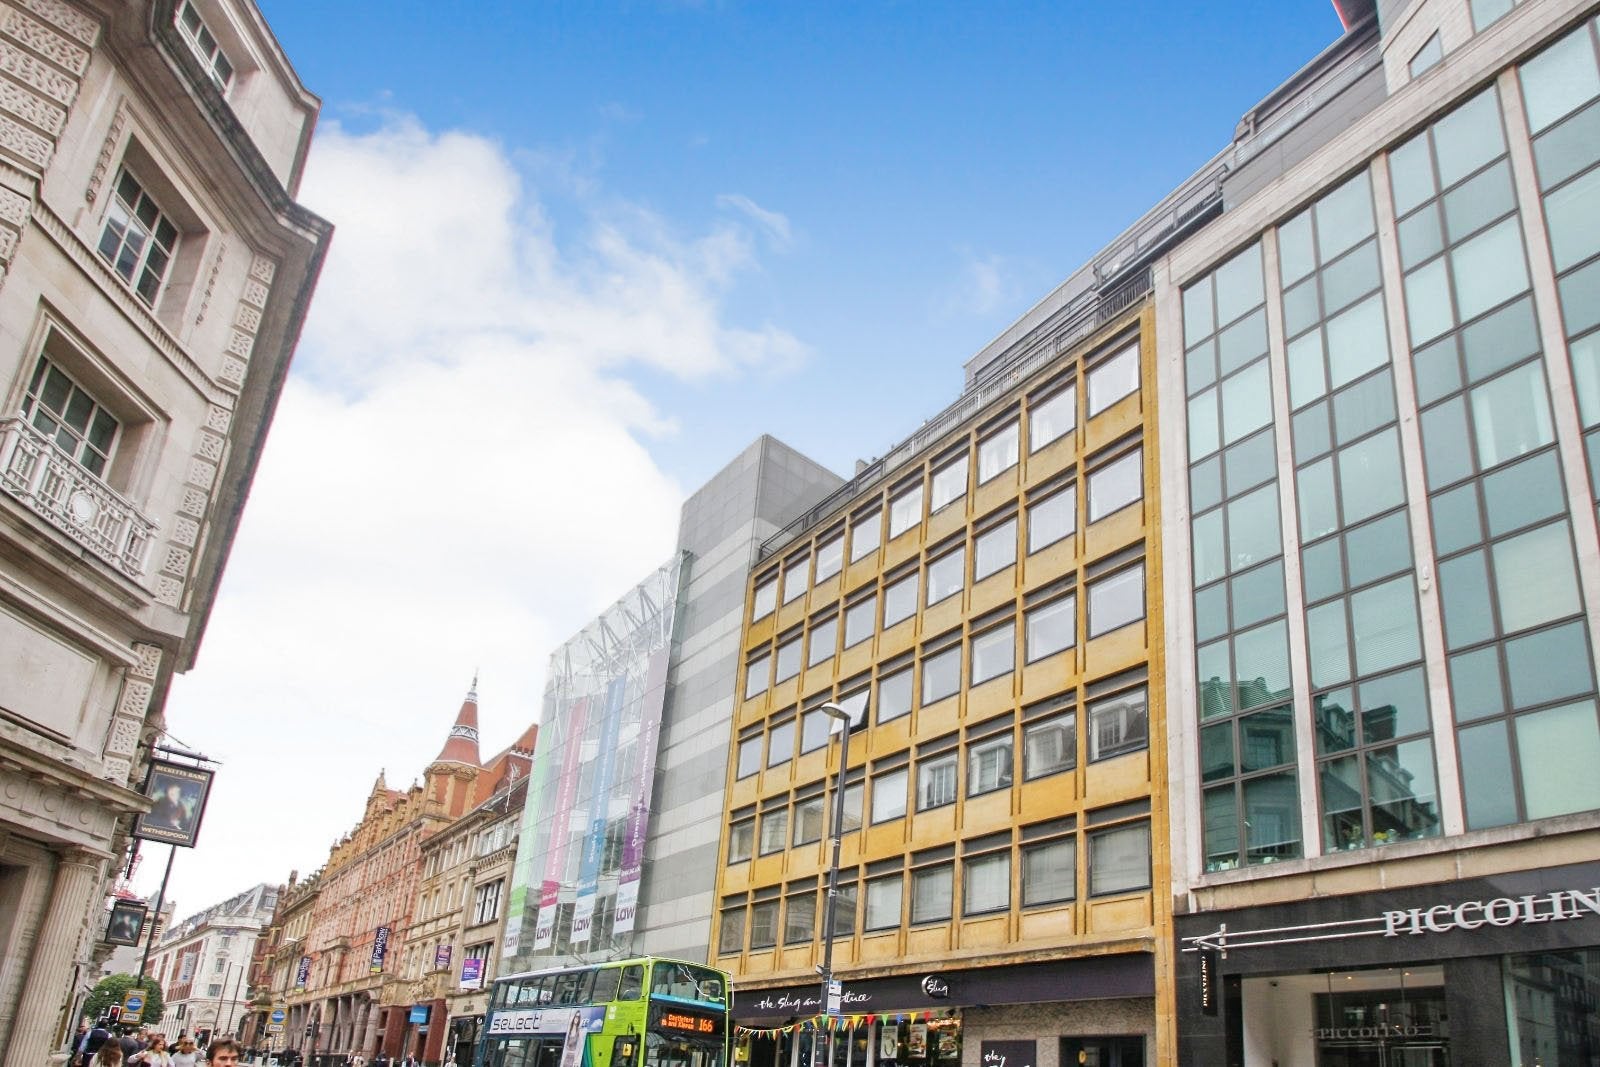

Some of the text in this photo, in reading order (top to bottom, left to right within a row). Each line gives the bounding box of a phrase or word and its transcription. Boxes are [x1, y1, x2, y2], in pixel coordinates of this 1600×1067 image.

[188, 773, 208, 781] BANK
[631, 802, 642, 847] Opening
[141, 827, 189, 840] WETHERSPOON
[754, 996, 776, 1009] the
[698, 1019, 713, 1033] 166
